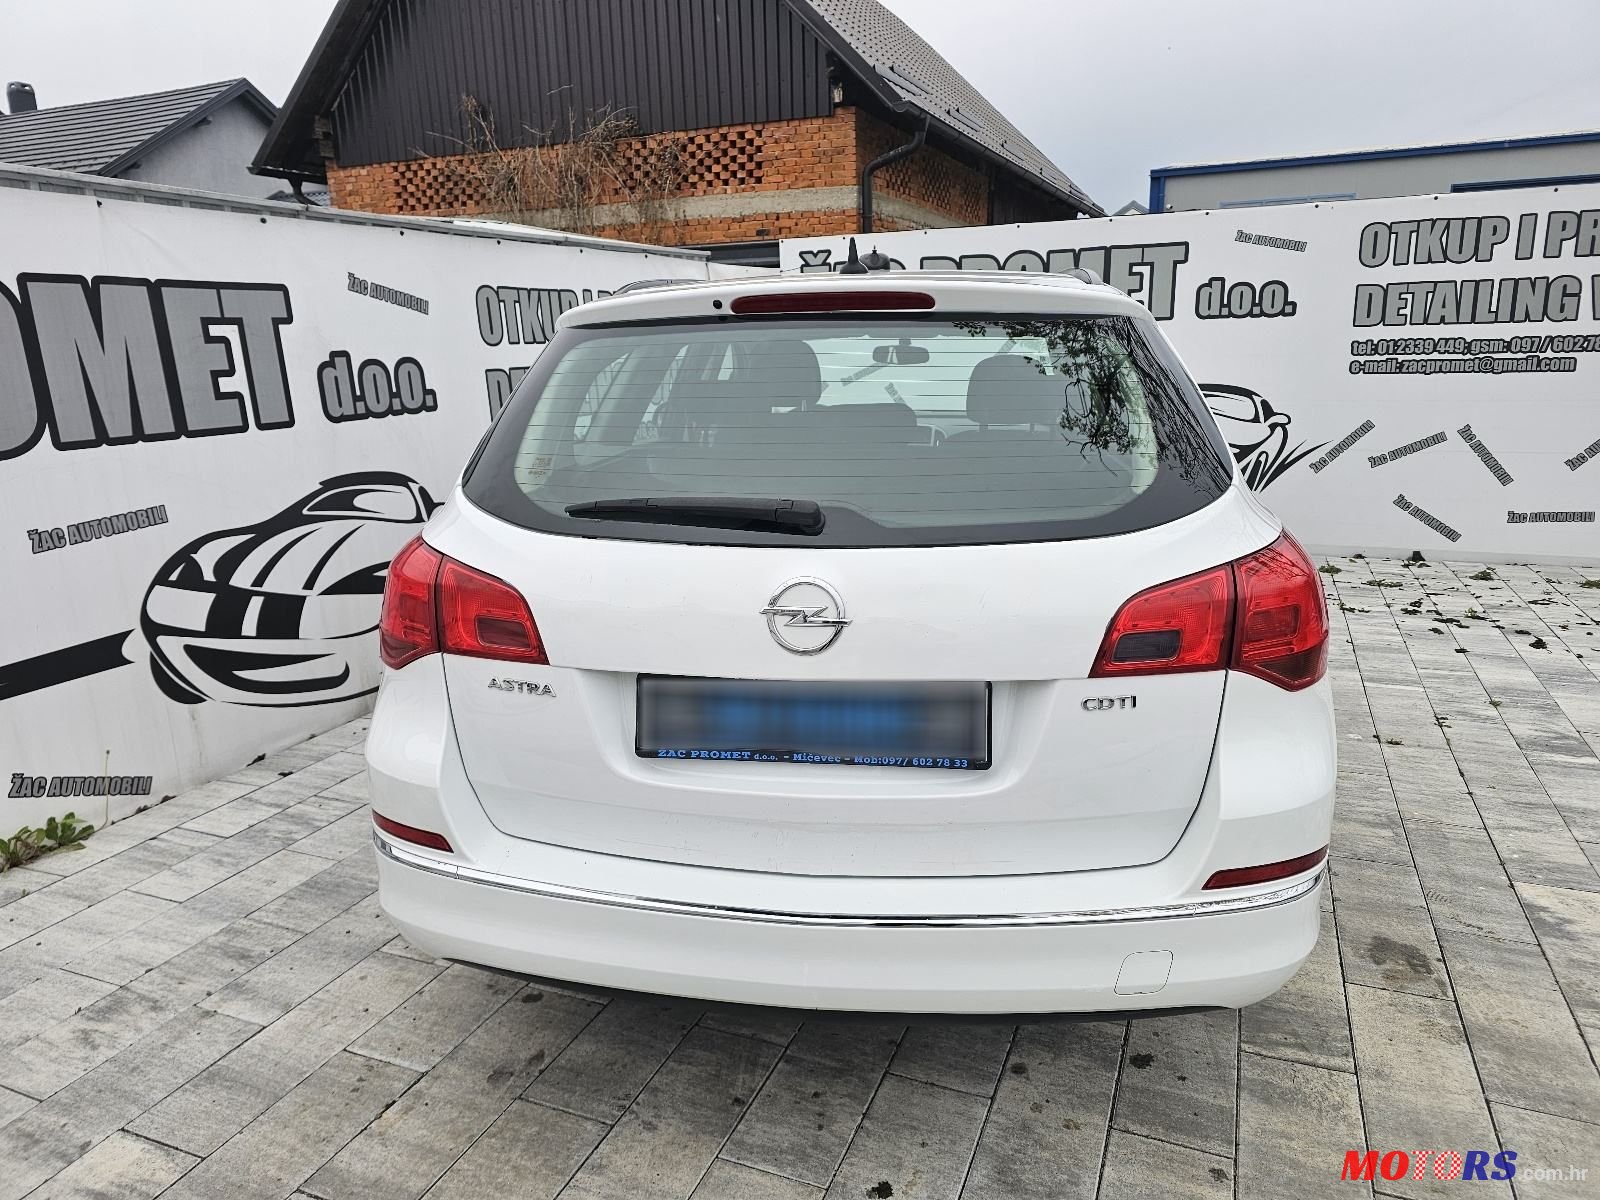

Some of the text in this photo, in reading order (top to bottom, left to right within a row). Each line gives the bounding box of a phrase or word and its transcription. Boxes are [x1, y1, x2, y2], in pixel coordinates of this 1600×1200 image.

[1359, 216, 1511, 267] OTKUP
[1515, 213, 1538, 260] I
[347, 271, 429, 315] ŽAC AUTOMOBILI
[1196, 277, 1297, 319] d.o.o.
[1353, 274, 1582, 327] DETAILING
[1350, 339, 1376, 356] tel:
[1469, 338, 1510, 355] gsm:
[1510, 336, 1542, 354] 097
[1552, 335, 1585, 353] 602
[1349, 355, 1577, 375] e-mail: zacpromet@gmail.com
[317, 350, 438, 423] d.o.o.
[1324, 419, 1376, 462] AUTOMOBILI
[1387, 430, 1448, 461] AUTOMOBILI
[26, 504, 169, 555] ŽAC AUTOMOBILI
[1407, 505, 1463, 543] AUTOMOBILI
[1527, 511, 1596, 523] AUTOMOBILI
[487, 677, 557, 698] ASTRA
[1081, 694, 1137, 711] CDTI
[690, 749, 751, 760] PROMET
[793, 753, 841, 763] Mičevec
[912, 757, 933, 767] 602
[936, 758, 951, 768] 78
[953, 758, 968, 769] 33
[8, 773, 154, 799] ŽAC AUTOMOBILI
